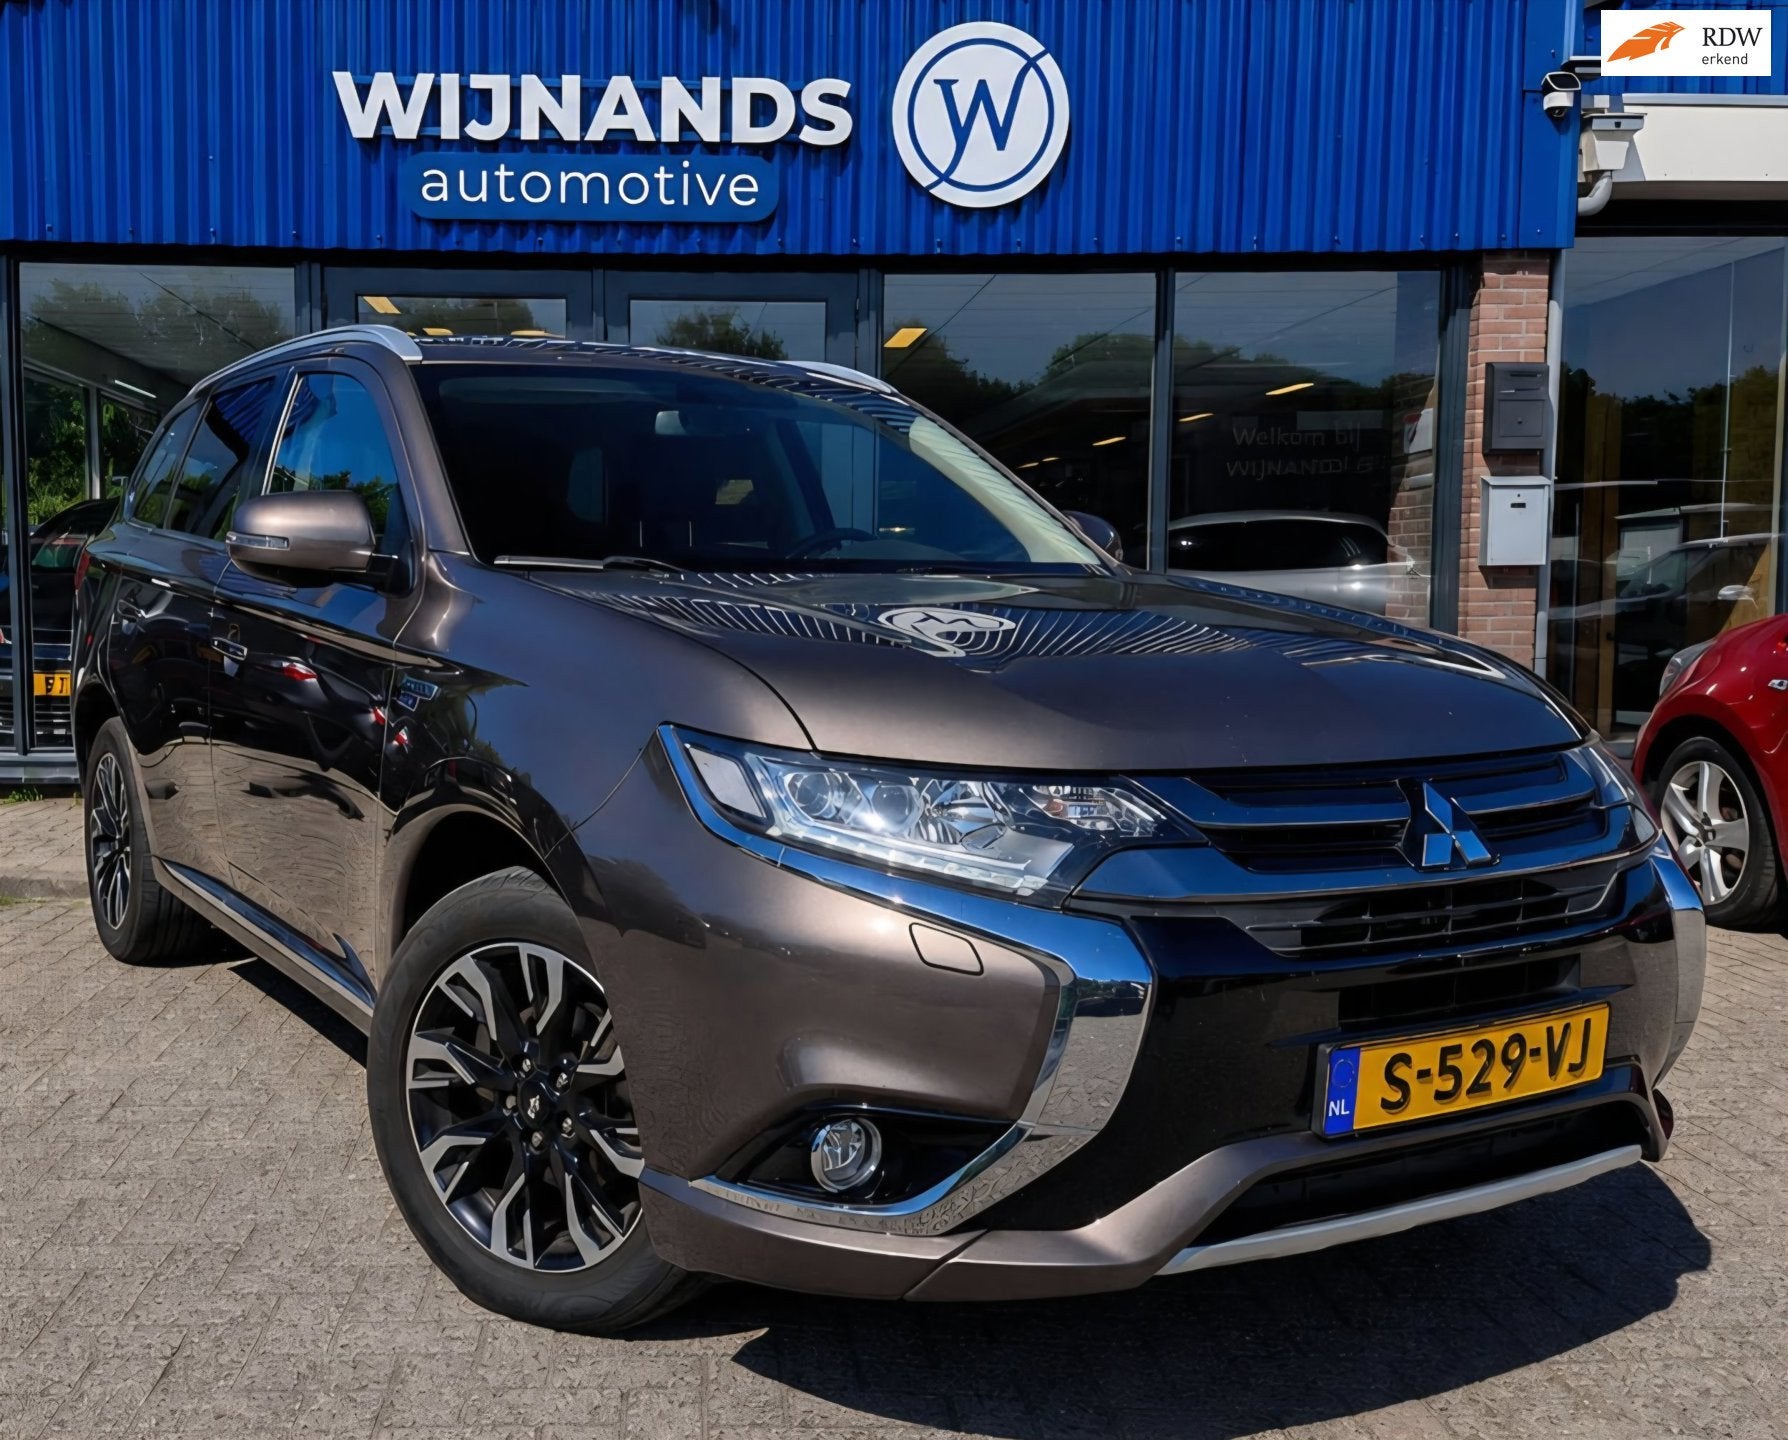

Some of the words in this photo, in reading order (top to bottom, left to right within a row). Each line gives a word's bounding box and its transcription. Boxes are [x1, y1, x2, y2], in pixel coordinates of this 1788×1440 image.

[332, 71, 852, 146] WIJNANDS
[421, 160, 760, 207] automotive
[1232, 426, 1326, 447] Welkom
[1380, 1017, 1592, 1115] S-529-VJ
[1328, 1099, 1350, 1117] NL
